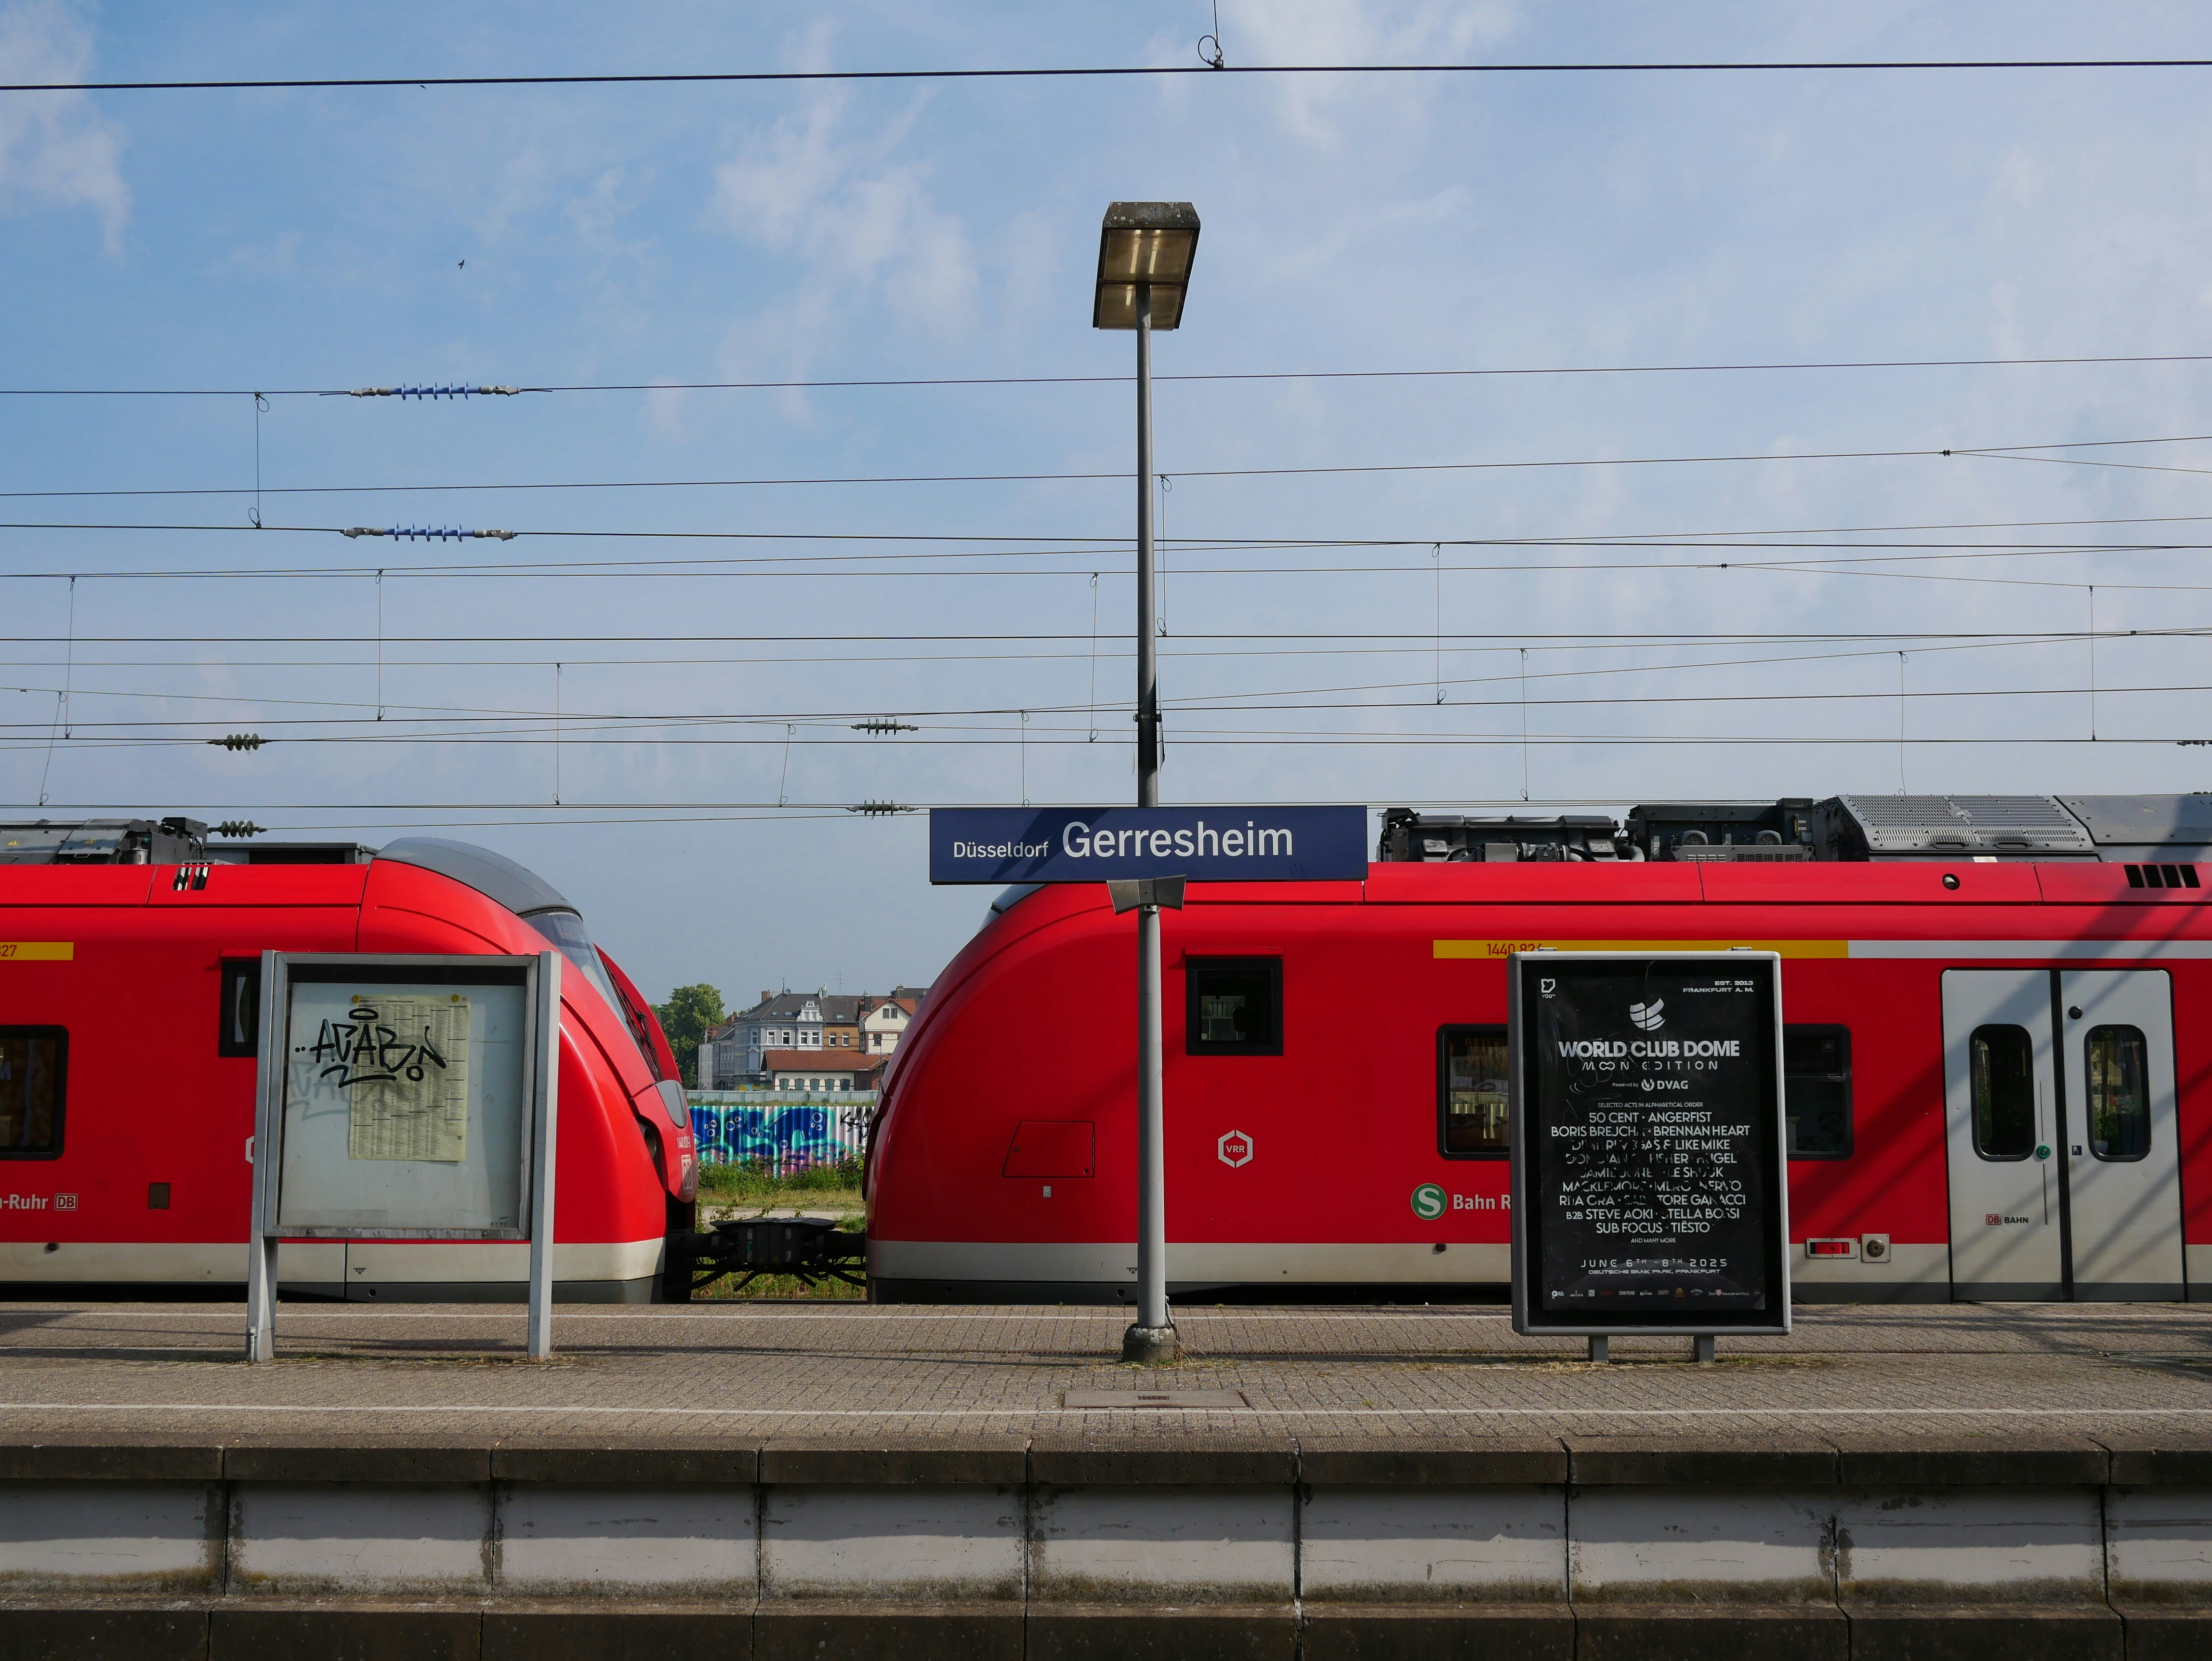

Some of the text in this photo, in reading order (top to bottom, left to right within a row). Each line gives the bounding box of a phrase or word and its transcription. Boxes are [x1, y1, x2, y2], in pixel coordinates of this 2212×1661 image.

[953, 820, 1293, 858] Düsseldorf Gerresheim
[0, 945, 17, 957] 27
[1558, 1041, 1740, 1058] WORLD CLUB DOME
[1642, 1061, 1718, 1070] EDITION
[1657, 1080, 1688, 1090] DVAG
[1589, 1111, 1712, 1123] 50 CENT ANGERFIST
[1551, 1126, 1587, 1137] BORIS
[1653, 1125, 1710, 1136] BRENNAN
[1712, 1125, 1751, 1136] HEART
[1675, 1139, 1699, 1150] LIKE
[1701, 1139, 1731, 1150] MIKE
[57, 1196, 75, 1208] DB
[1453, 1194, 1496, 1210] Bahn
[1566, 1211, 1583, 1220] B2B
[1586, 1209, 1621, 1220] STEVE
[1623, 1208, 1653, 1220] AOKI
[1988, 1215, 2000, 1224] DB
[1596, 1220, 1710, 1234] SUB FOCUS TIËSTO
[1580, 1259, 1617, 1267] JUNE
[1690, 1259, 1727, 1267] 2025
